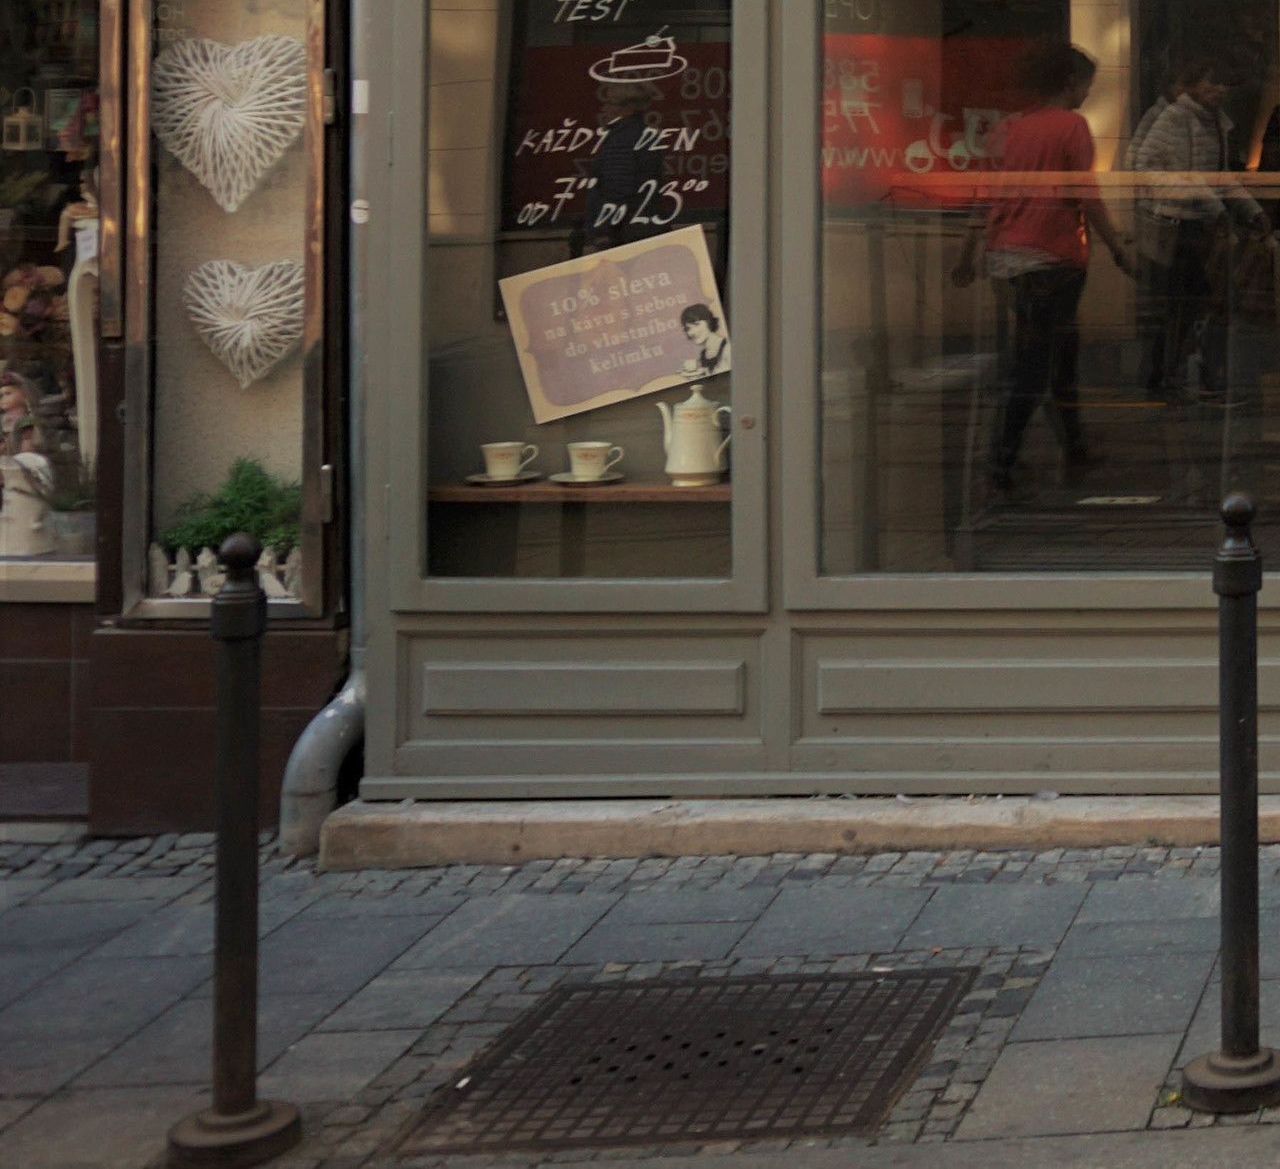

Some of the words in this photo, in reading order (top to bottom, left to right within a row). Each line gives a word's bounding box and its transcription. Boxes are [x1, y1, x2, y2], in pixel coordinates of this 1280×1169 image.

[515, 116, 623, 157] KAŽDÝ
[633, 127, 701, 153] DEN
[516, 201, 549, 226] OD
[593, 202, 628, 228] DO
[549, 287, 600, 318] 10%
[607, 270, 672, 302] sleva
